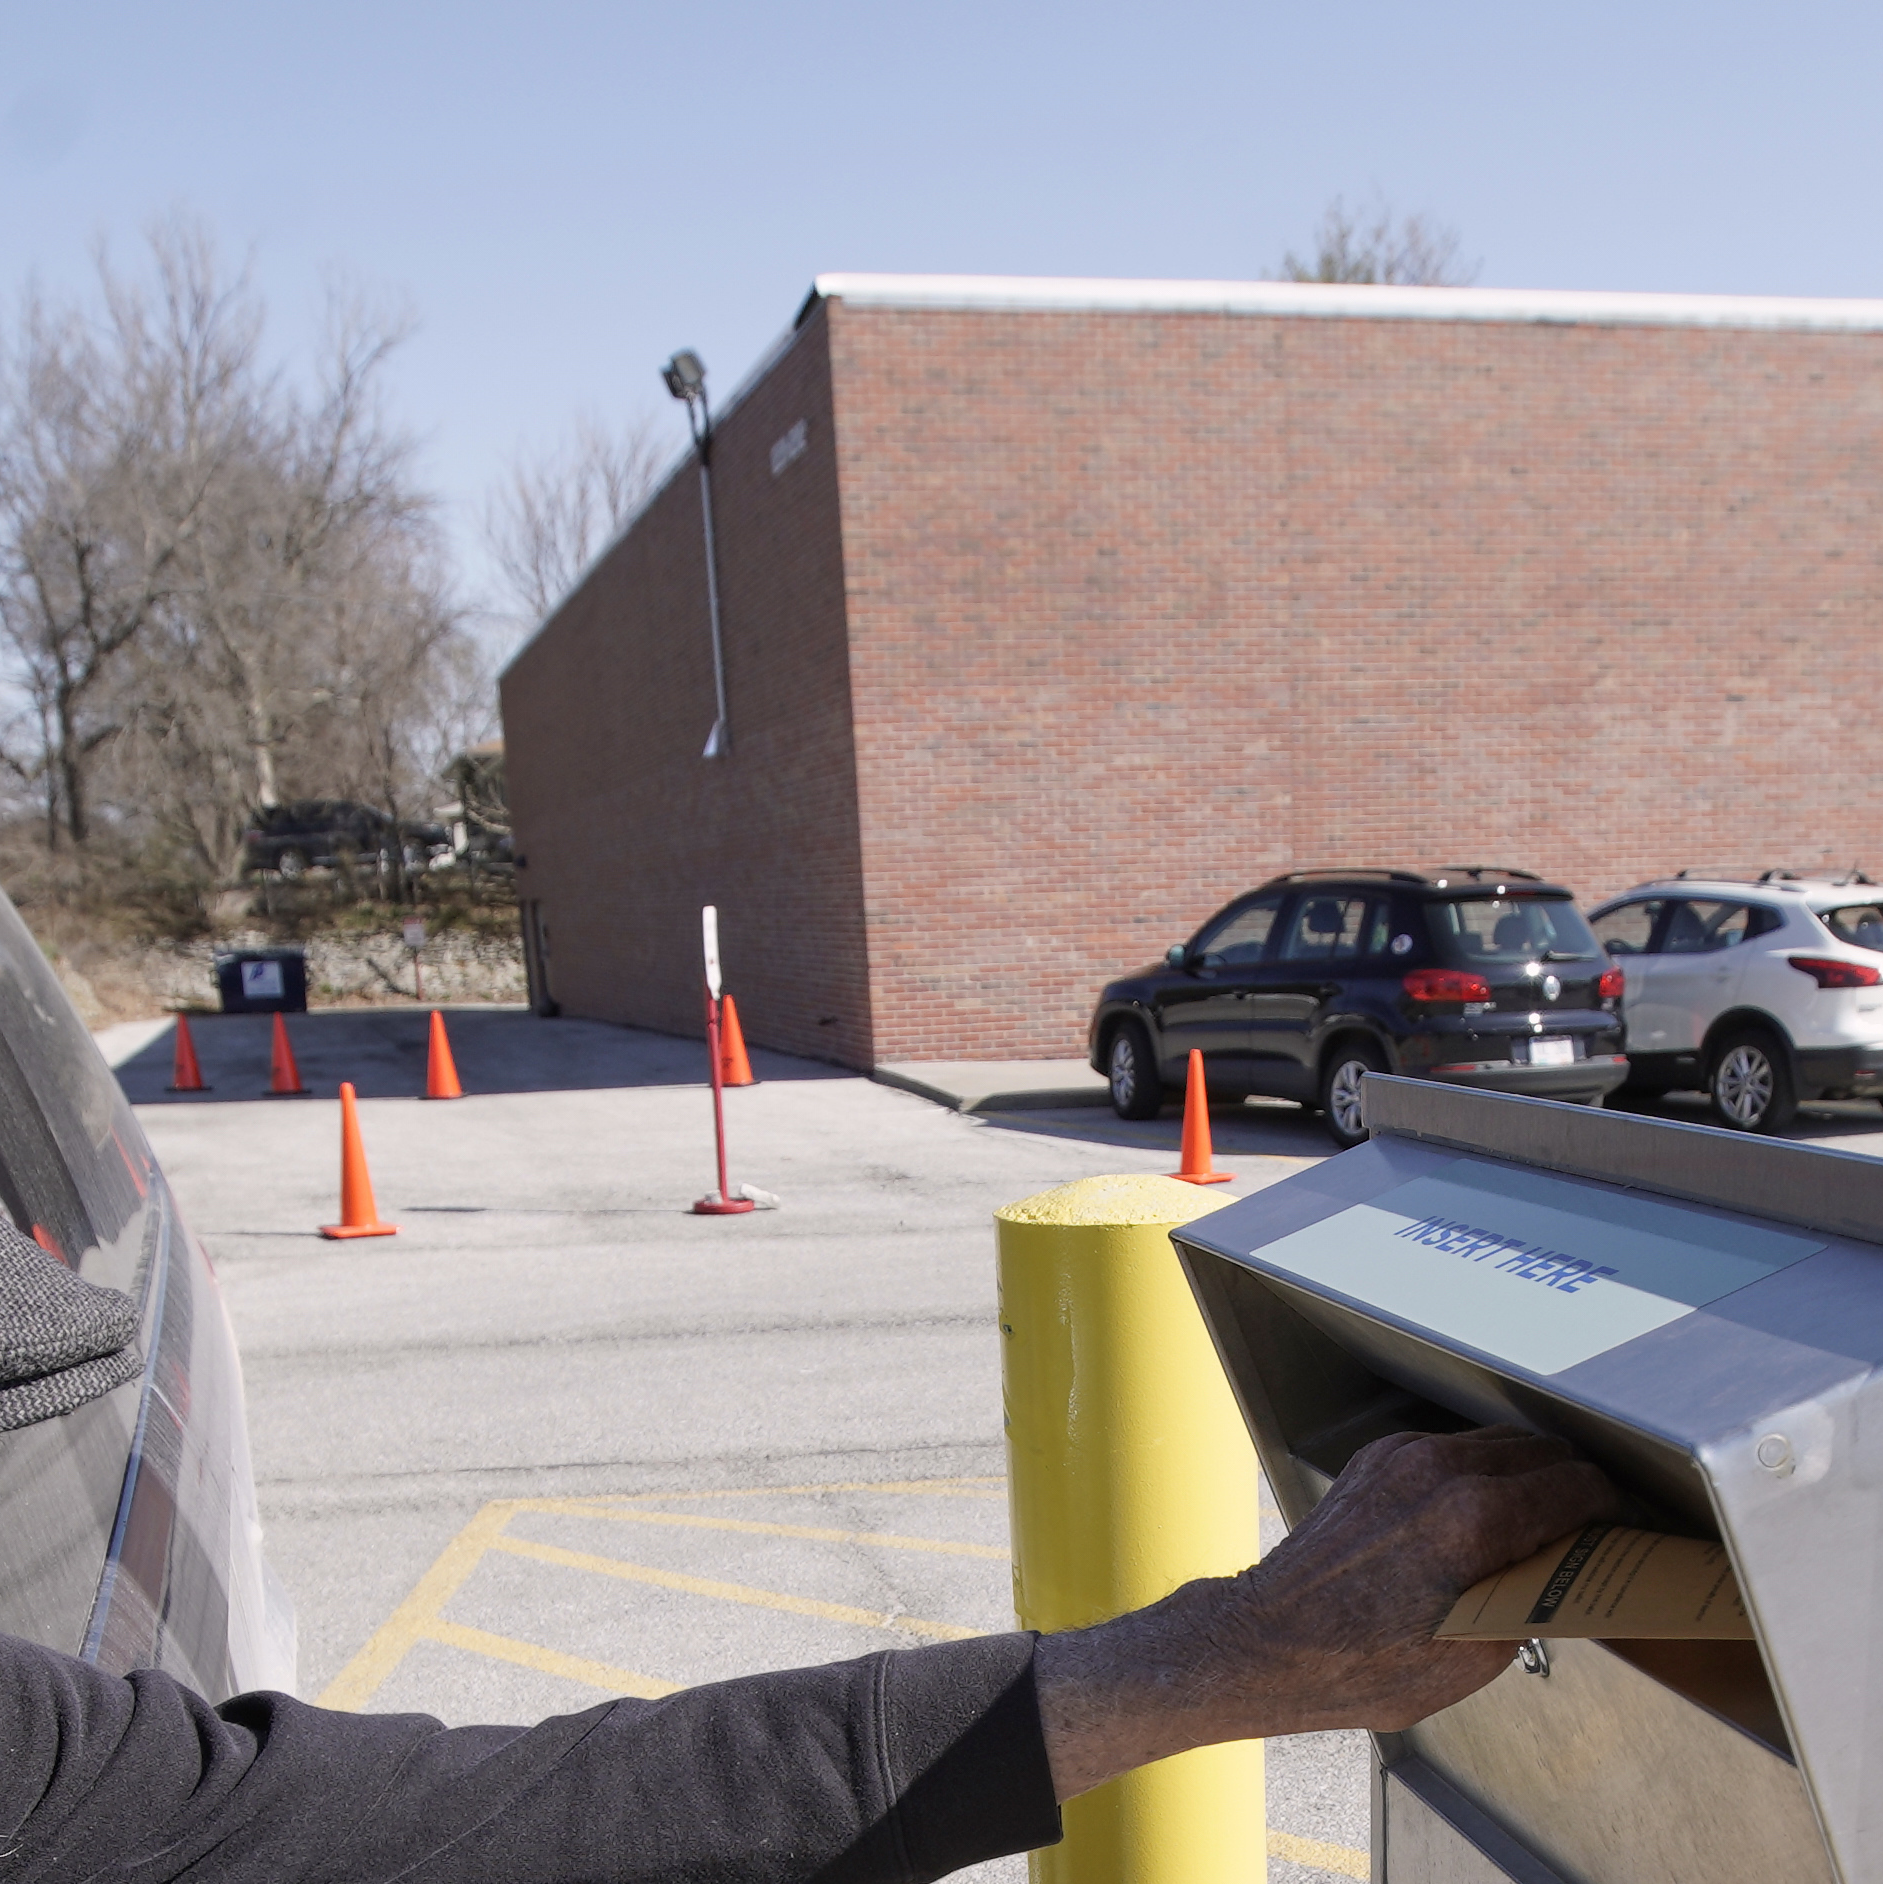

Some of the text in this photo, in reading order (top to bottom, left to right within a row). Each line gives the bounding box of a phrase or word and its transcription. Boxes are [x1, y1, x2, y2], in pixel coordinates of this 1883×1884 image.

[1393, 1215, 1620, 1294] INSERT HERE
[1564, 1547, 1589, 1570] SIGN
[1541, 1570, 1575, 1608] BELOW
